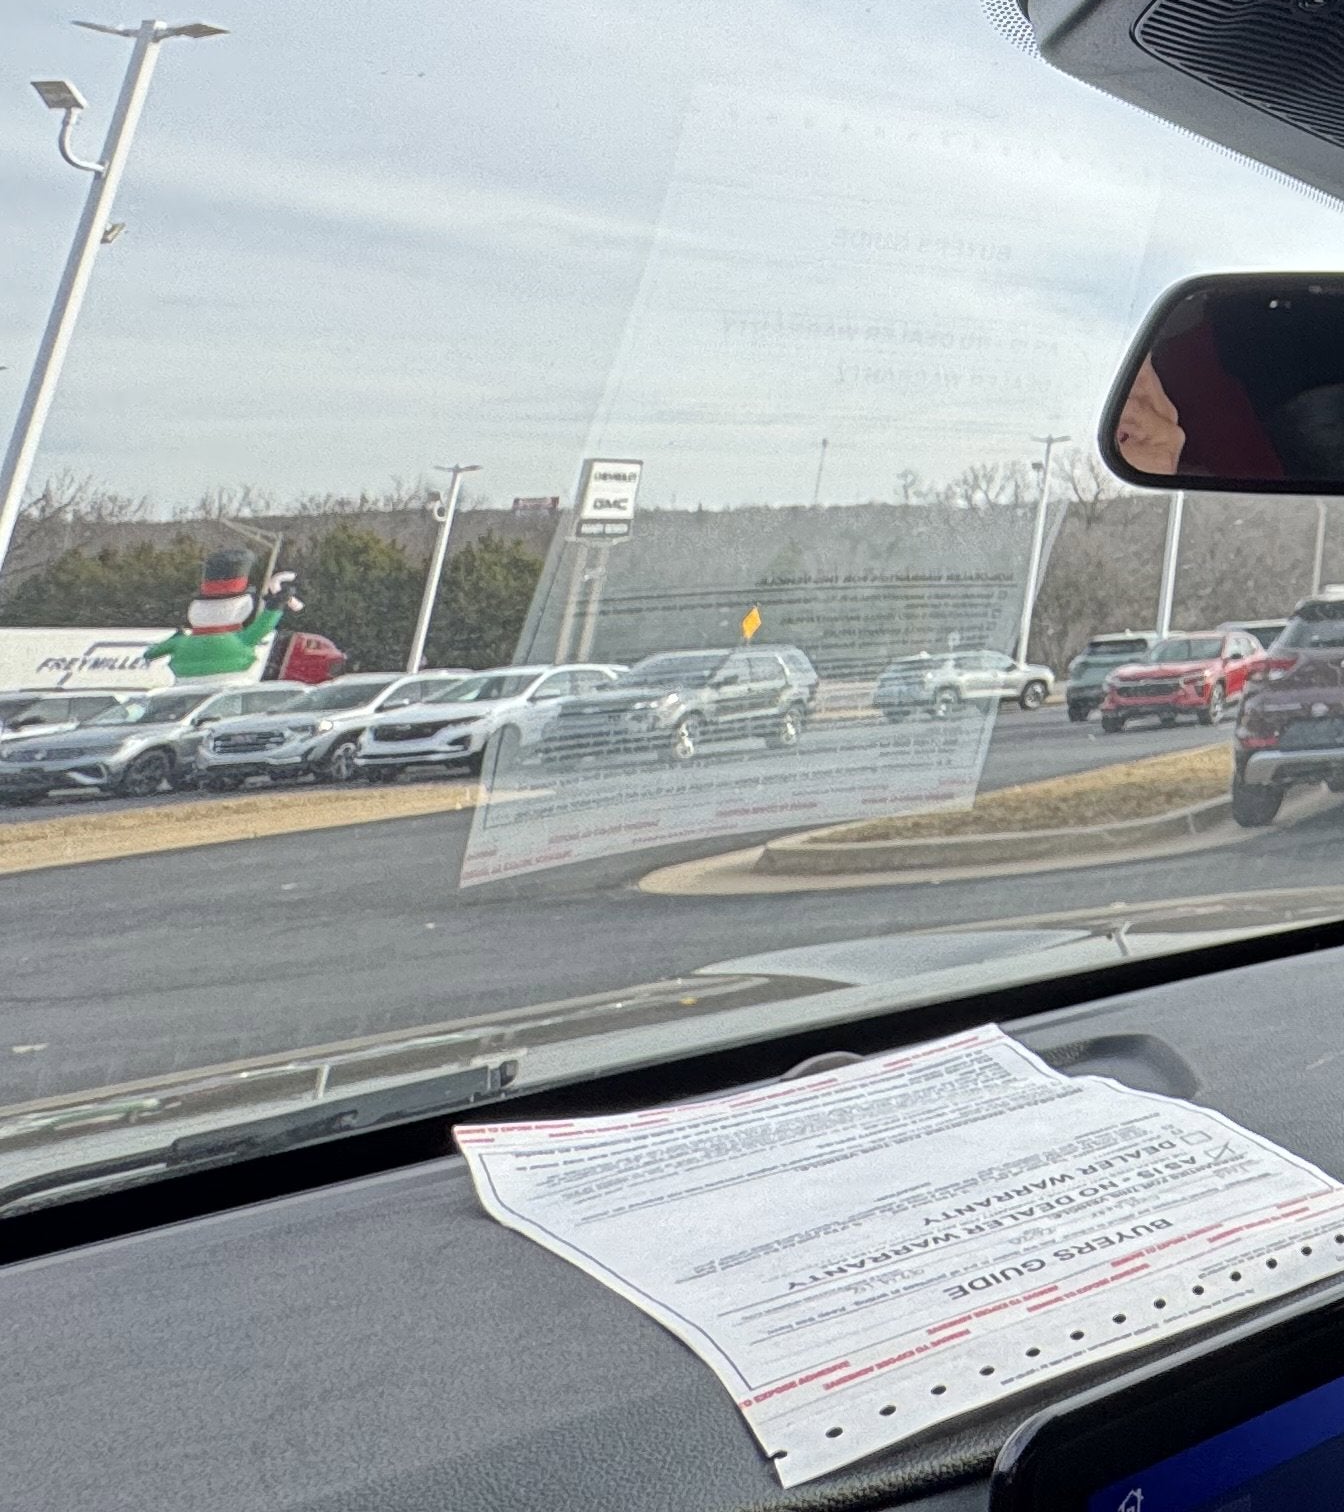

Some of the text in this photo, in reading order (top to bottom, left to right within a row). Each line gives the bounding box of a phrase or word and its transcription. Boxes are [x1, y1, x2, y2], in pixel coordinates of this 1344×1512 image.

[1075, 1139, 1176, 1175] DEALER
[1136, 1166, 1164, 1179] IS
[1164, 1155, 1197, 1170] AS
[923, 1173, 1075, 1226] WARRANTY
[1078, 1180, 1119, 1197] NO
[960, 1194, 1076, 1234] DEALER
[1052, 1218, 1174, 1261] BUYERS
[788, 1232, 961, 1290] WARRANTY
[944, 1257, 1047, 1300] GUIDE
